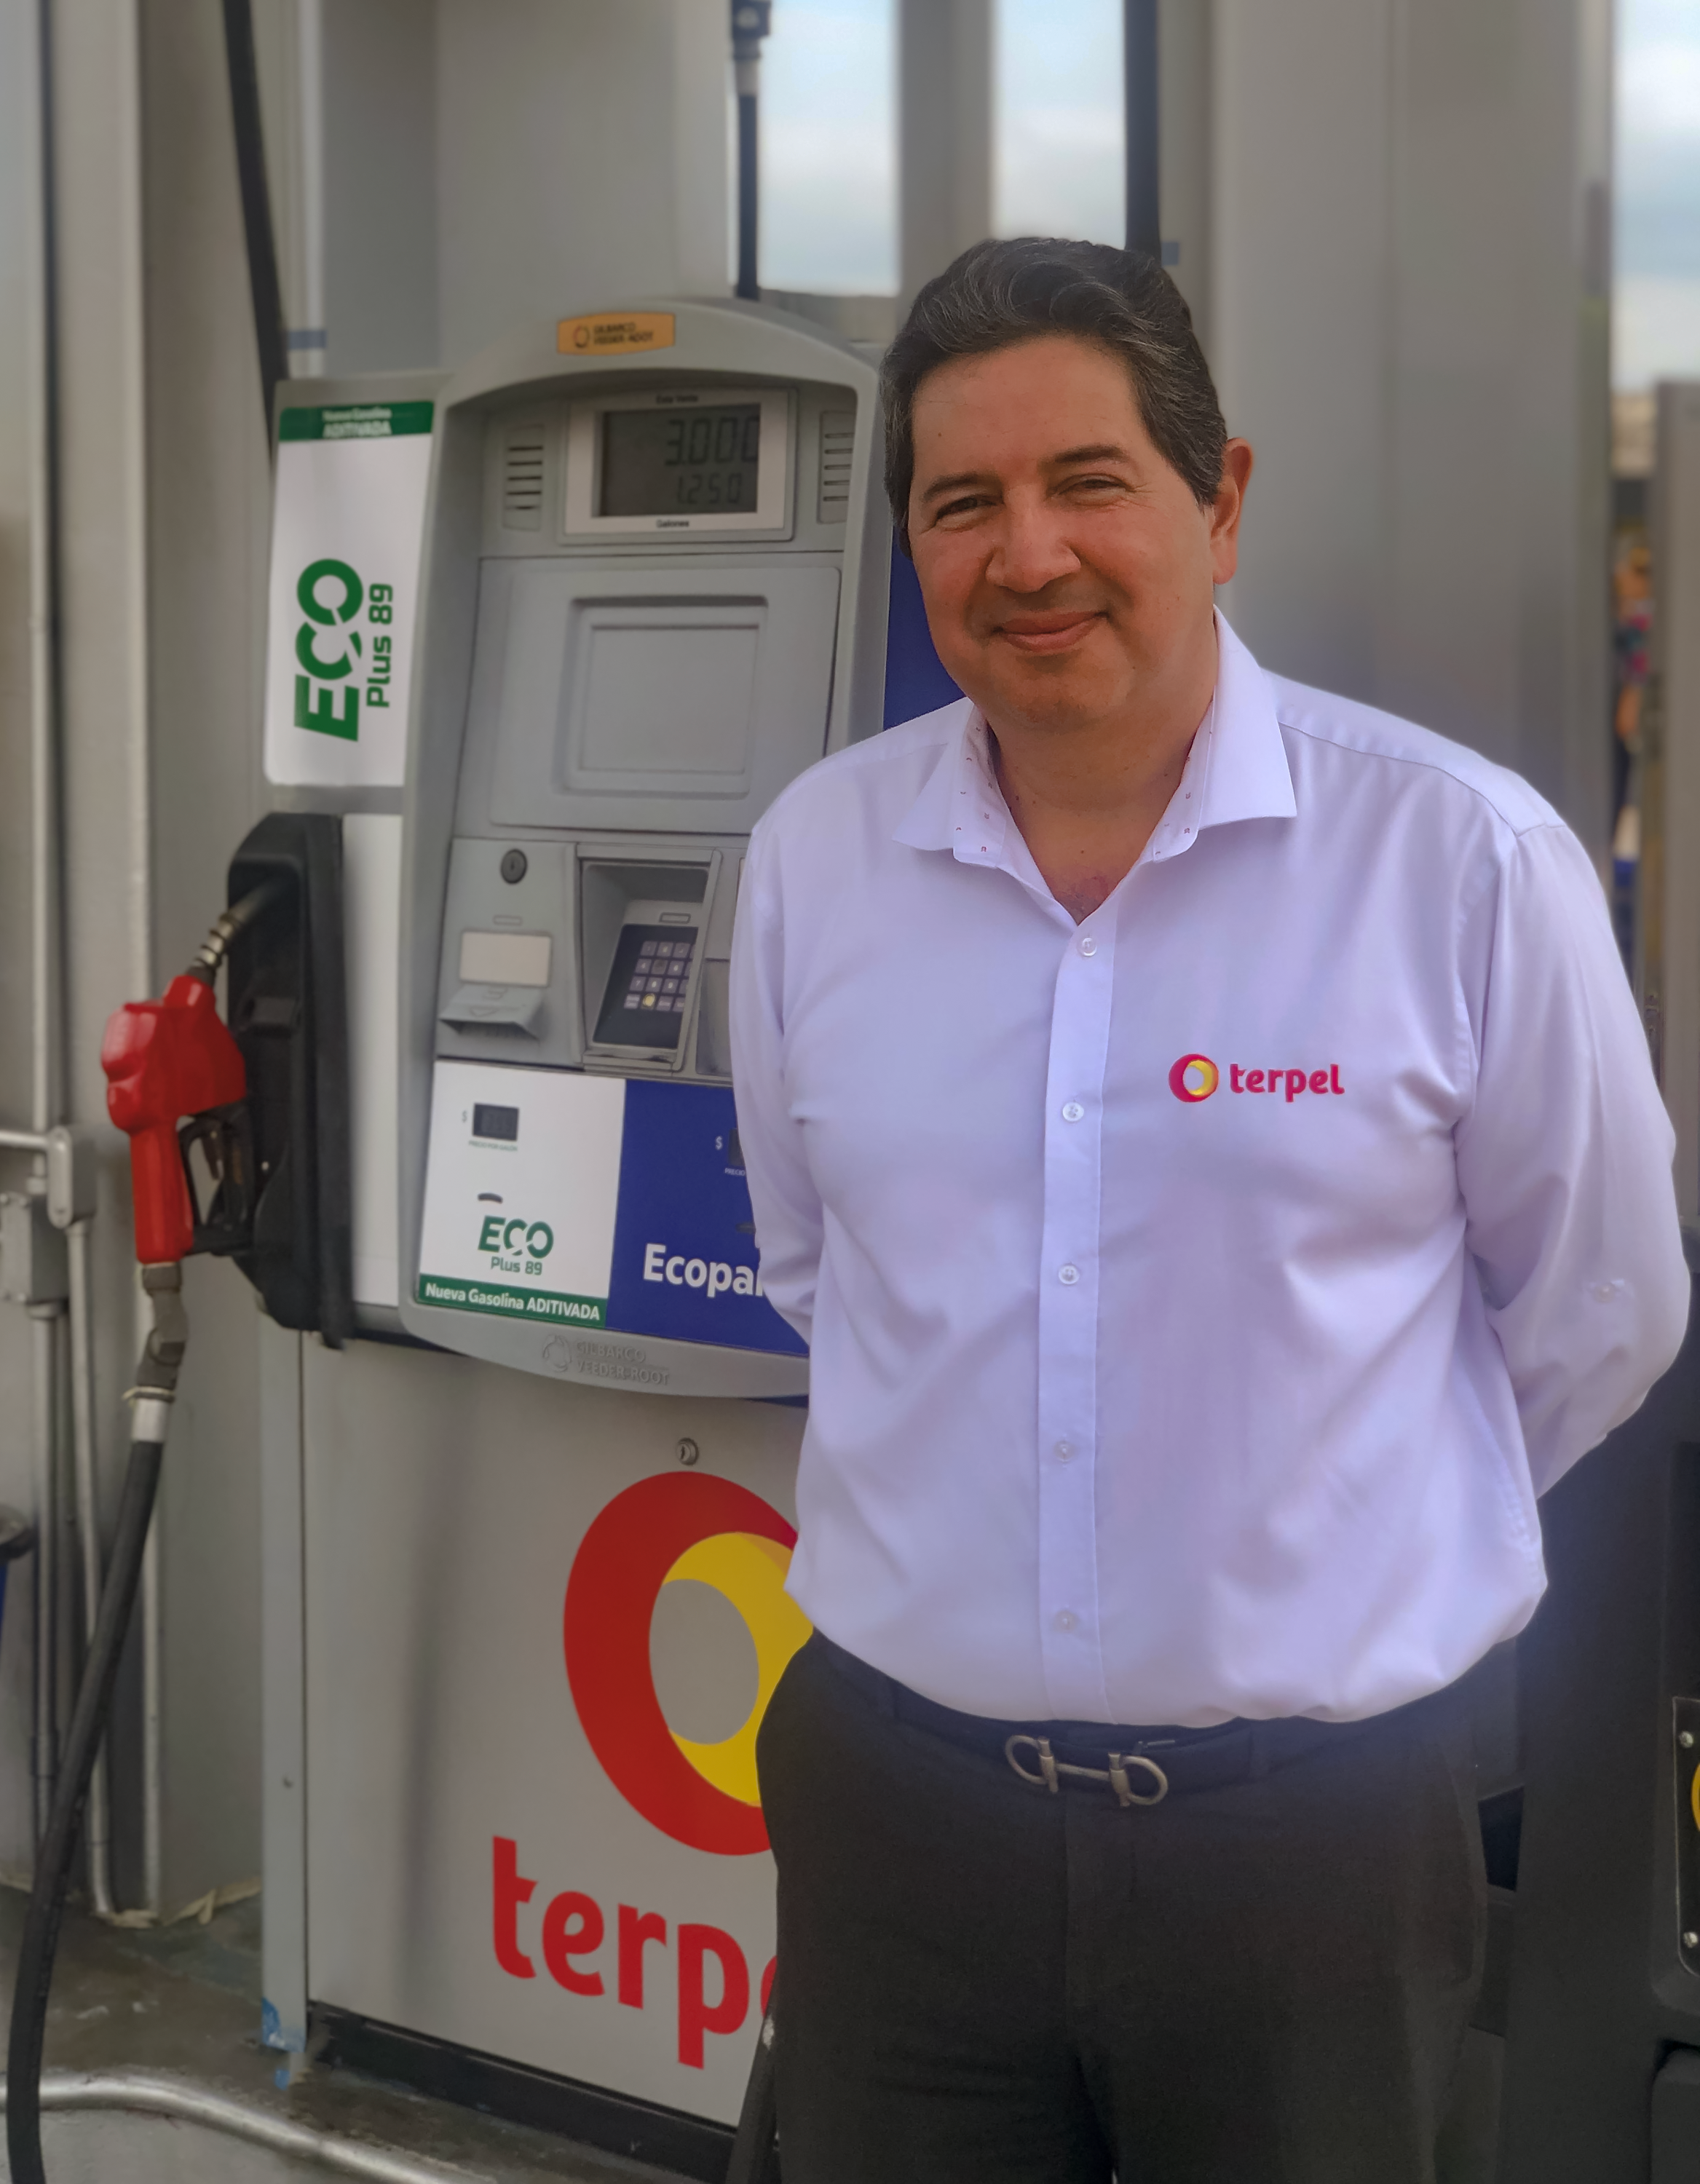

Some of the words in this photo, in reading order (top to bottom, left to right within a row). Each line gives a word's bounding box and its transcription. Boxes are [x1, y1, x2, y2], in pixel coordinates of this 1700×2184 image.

[656, 520, 689, 529] Galones
[368, 583, 394, 625] 89
[294, 558, 363, 742] ECO
[366, 636, 392, 708] Plus
[1230, 1064, 1345, 1102] terpel
[716, 1136, 722, 1150] $
[724, 1167, 746, 1176] PRECIO
[478, 1215, 554, 1259] ECO
[491, 1256, 521, 1273] Plus
[525, 1260, 543, 1276] 89
[425, 1282, 466, 1302] Nueva
[468, 1288, 524, 1310] Gasolina
[526, 1297, 601, 1321] ADITIVADA
[577, 1342, 647, 1364] GILBARCO
